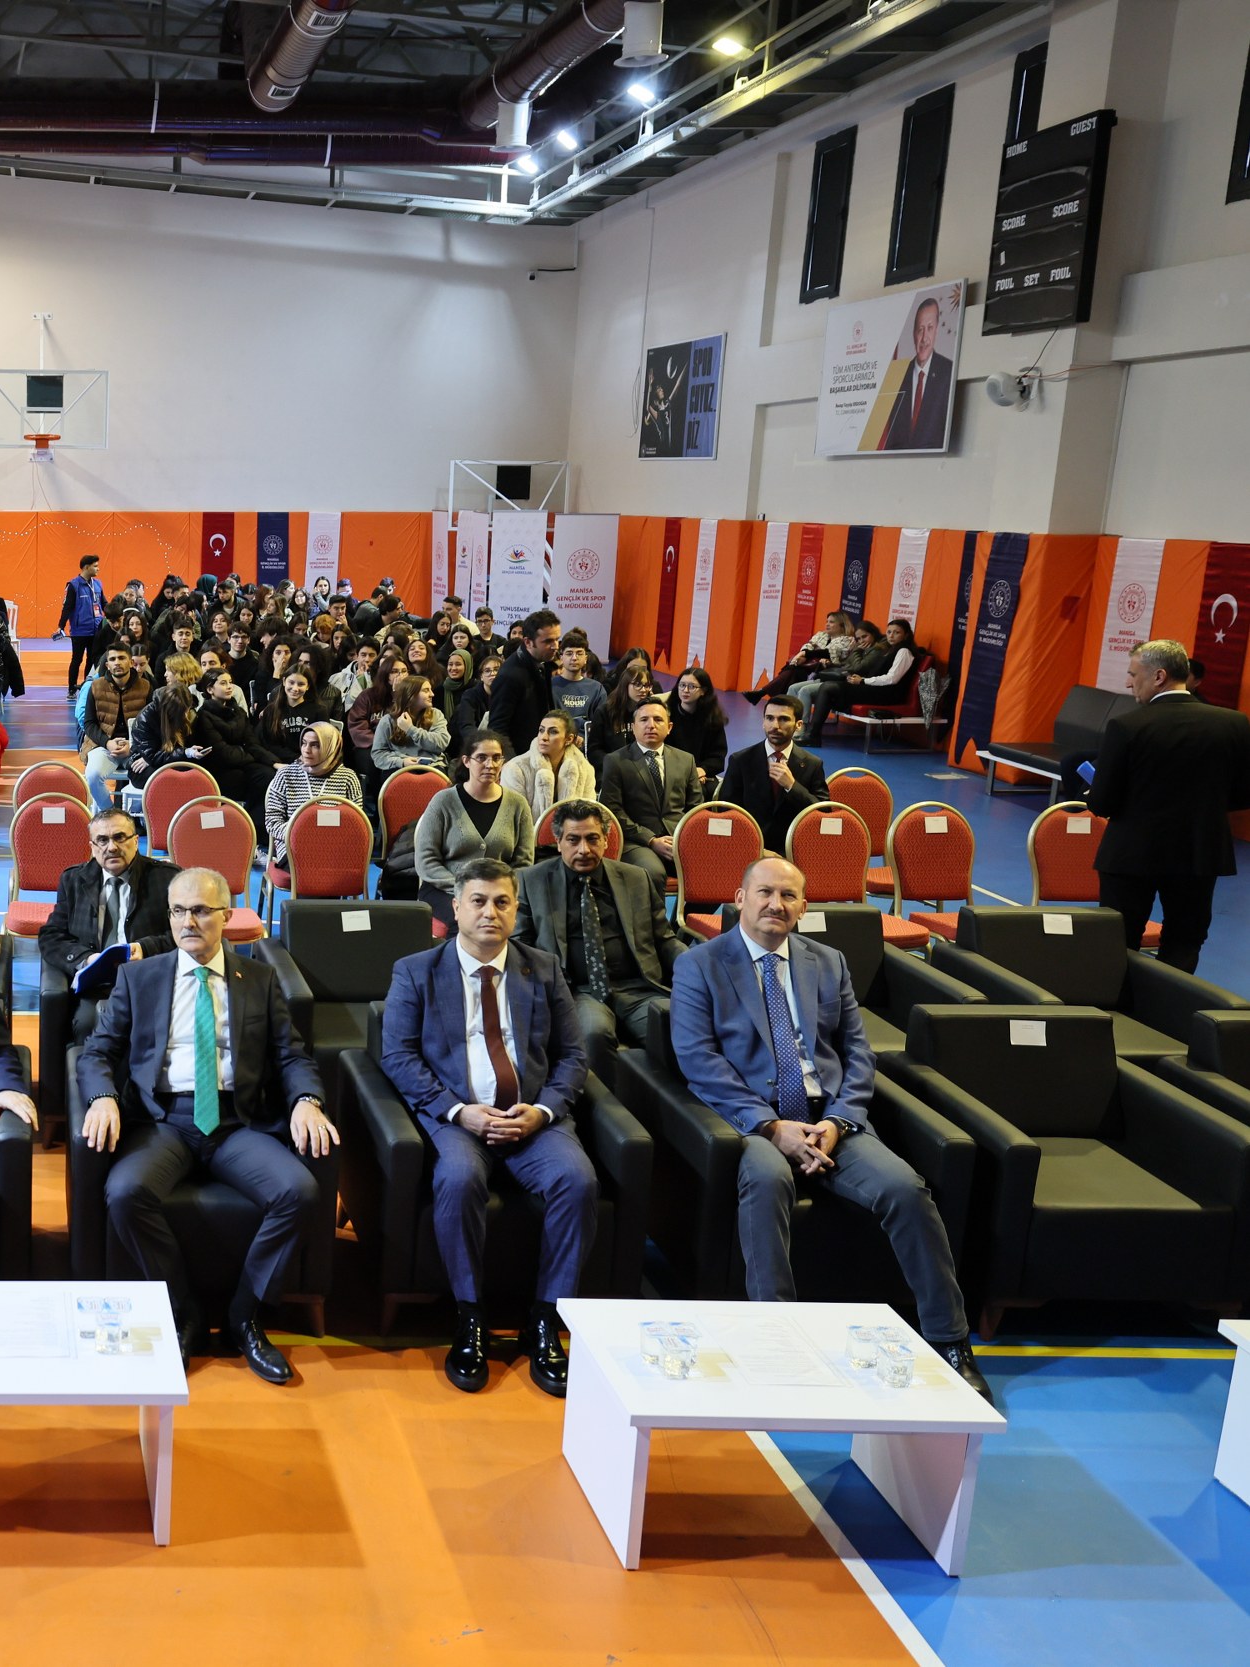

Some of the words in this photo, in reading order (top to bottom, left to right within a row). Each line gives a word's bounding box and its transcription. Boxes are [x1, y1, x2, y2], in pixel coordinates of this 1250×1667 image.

[1006, 141, 1028, 158] HOME
[1070, 116, 1098, 136] GUEST
[1002, 215, 1027, 231] SCORE
[1052, 200, 1080, 218] SCORE
[995, 277, 1015, 292] FOUL
[1023, 272, 1040, 287] SET
[1049, 266, 1072, 282] FOUL
